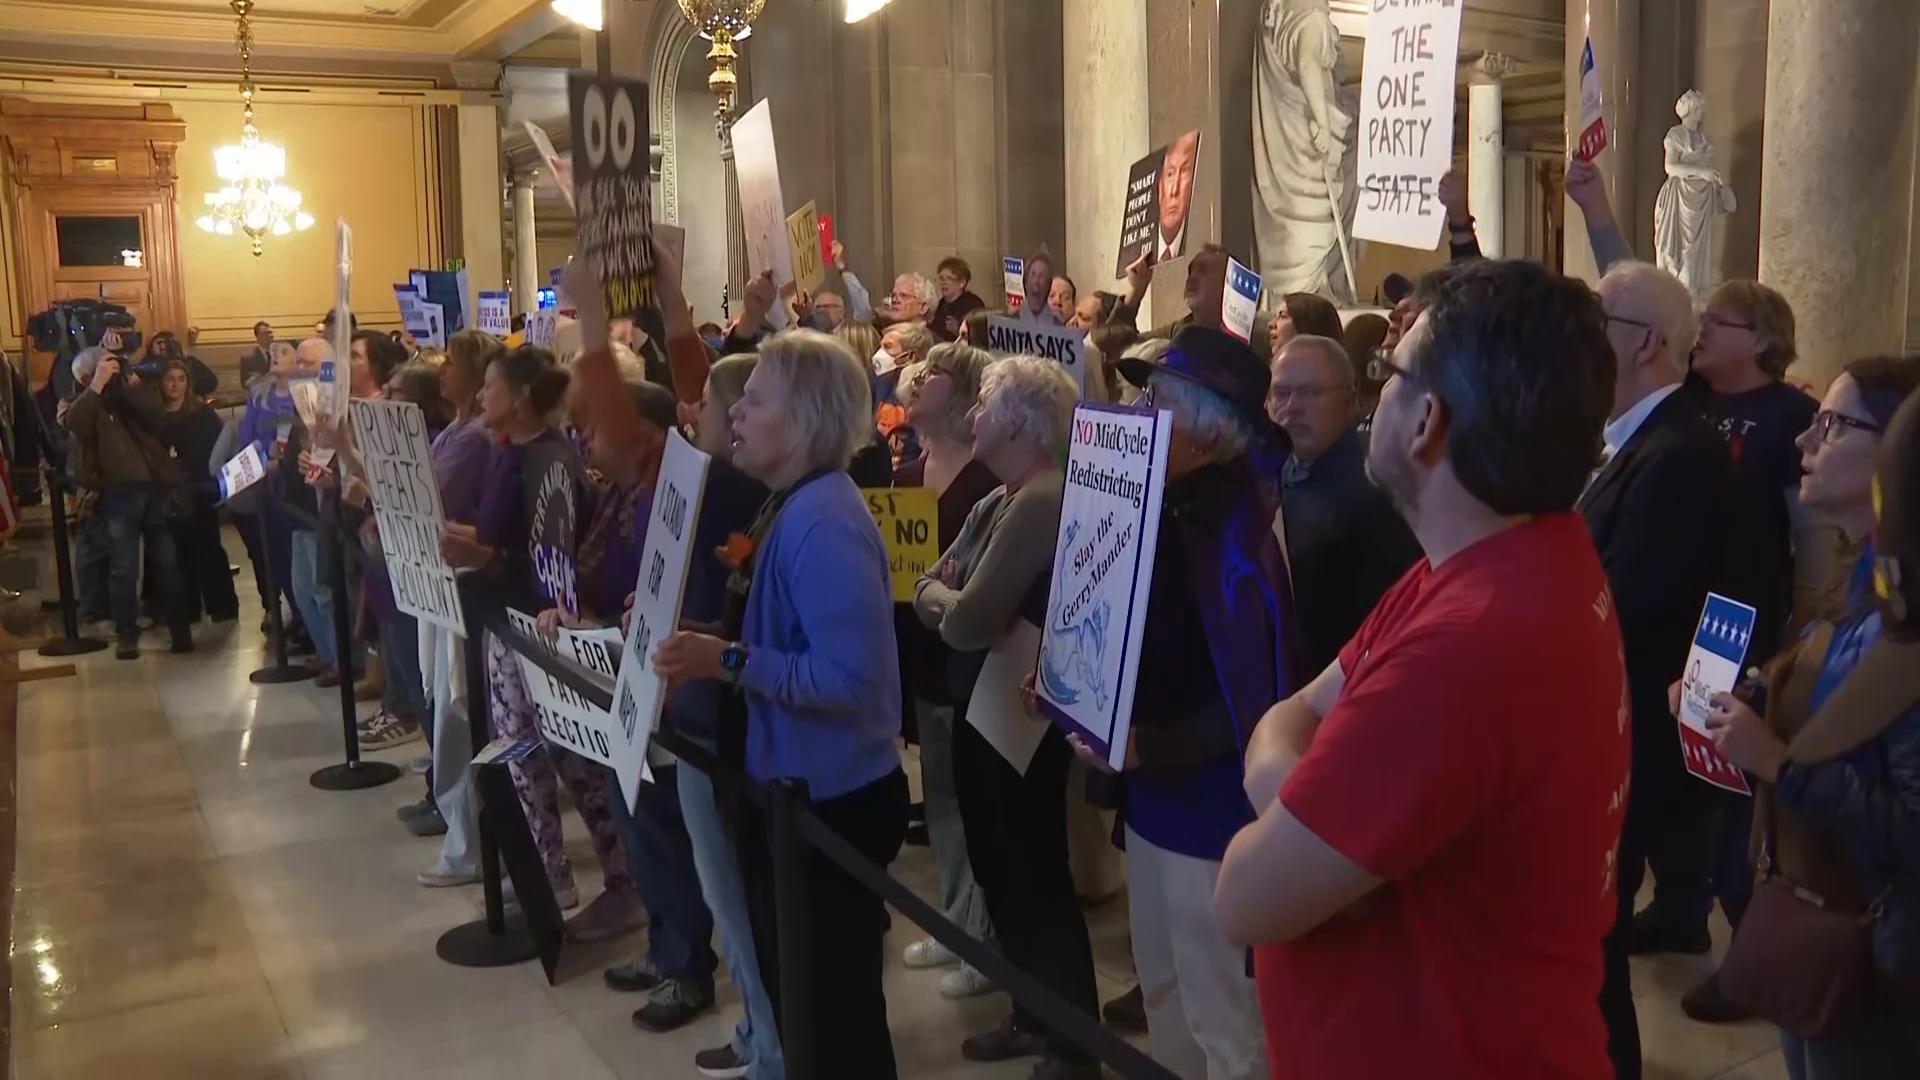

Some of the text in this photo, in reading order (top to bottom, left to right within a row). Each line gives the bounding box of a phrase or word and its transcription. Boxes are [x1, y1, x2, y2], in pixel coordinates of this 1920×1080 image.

[1391, 23, 1433, 63] THE
[1377, 71, 1426, 110] ONE
[1368, 117, 1432, 158] PARTY
[1127, 190, 1152, 212] PEOPLE
[1365, 173, 1432, 215] STATE
[1122, 230, 1138, 247] LIKE
[989, 324, 1076, 365] SANTA SAYS
[350, 402, 420, 461] TRUMP
[1074, 419, 1148, 459] NO MidCycle
[364, 454, 433, 516] CHEATS
[1069, 460, 1143, 509] Redistricting
[663, 481, 689, 542] STAND
[895, 518, 929, 547] NO
[1073, 511, 1115, 577] Slay the
[648, 548, 666, 602] FOR
[1062, 522, 1133, 627] GerryMander
[570, 634, 611, 676] FOR
[633, 613, 651, 672] FAIR
[534, 701, 610, 760] ELECTIO
